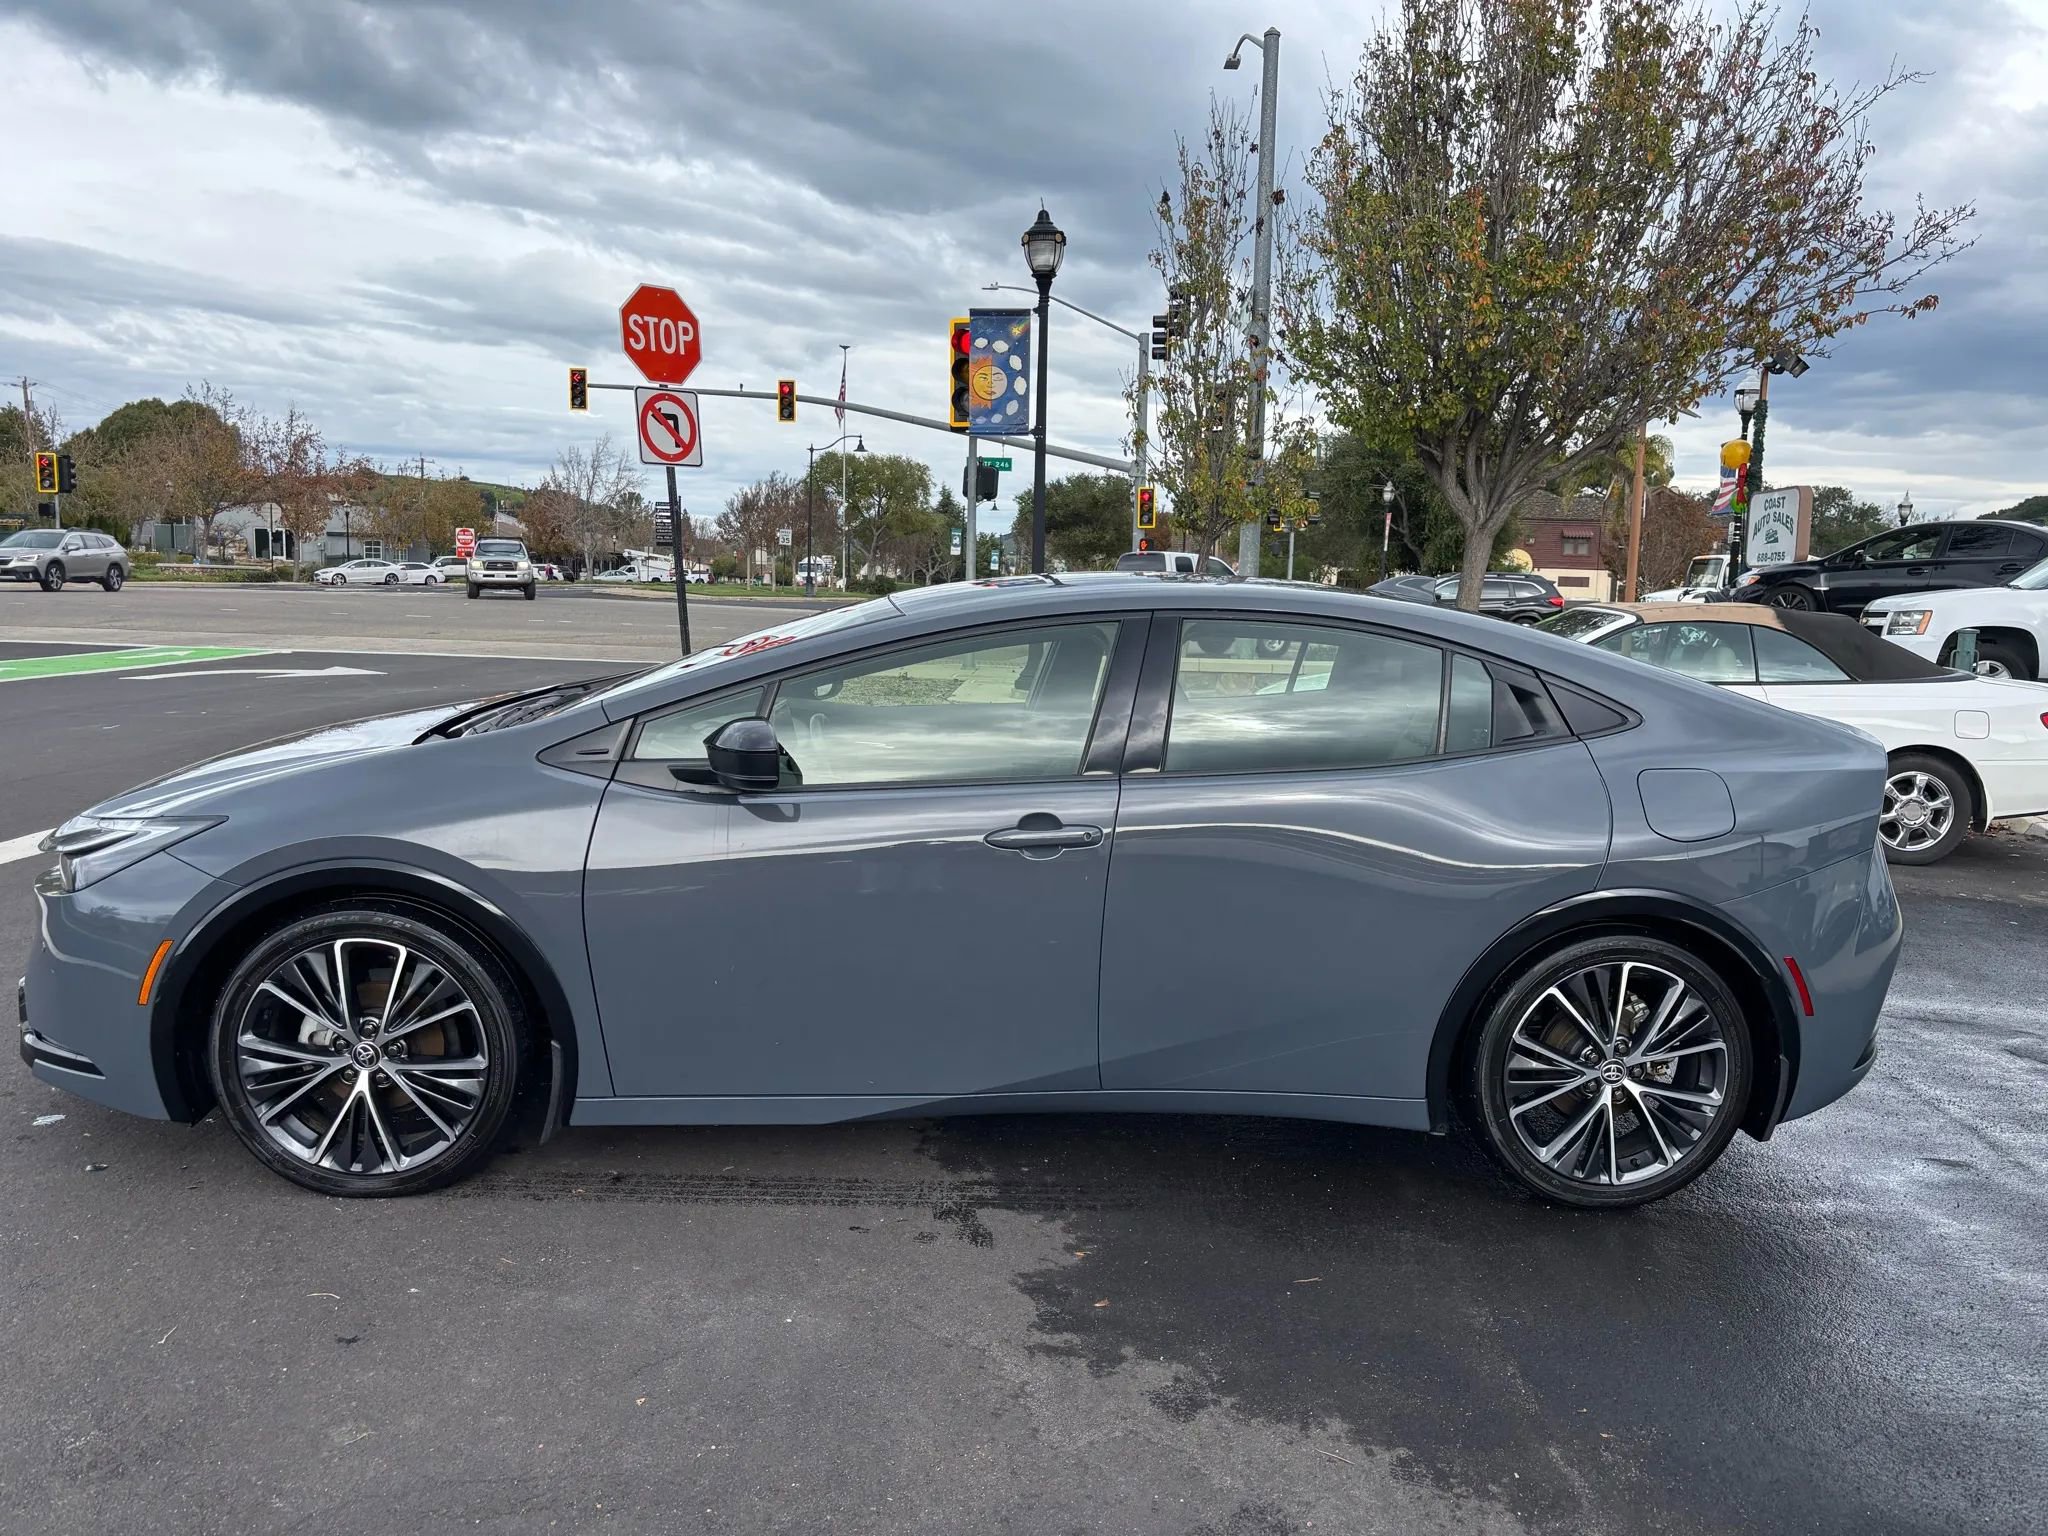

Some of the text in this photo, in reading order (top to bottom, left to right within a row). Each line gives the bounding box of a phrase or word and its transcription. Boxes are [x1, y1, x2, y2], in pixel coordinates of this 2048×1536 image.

[628, 313, 694, 355] STOP
[1764, 496, 1786, 511] COAST
[1752, 512, 1771, 540] AUTO
[1773, 511, 1794, 536] SALES
[780, 536, 791, 544] 35
